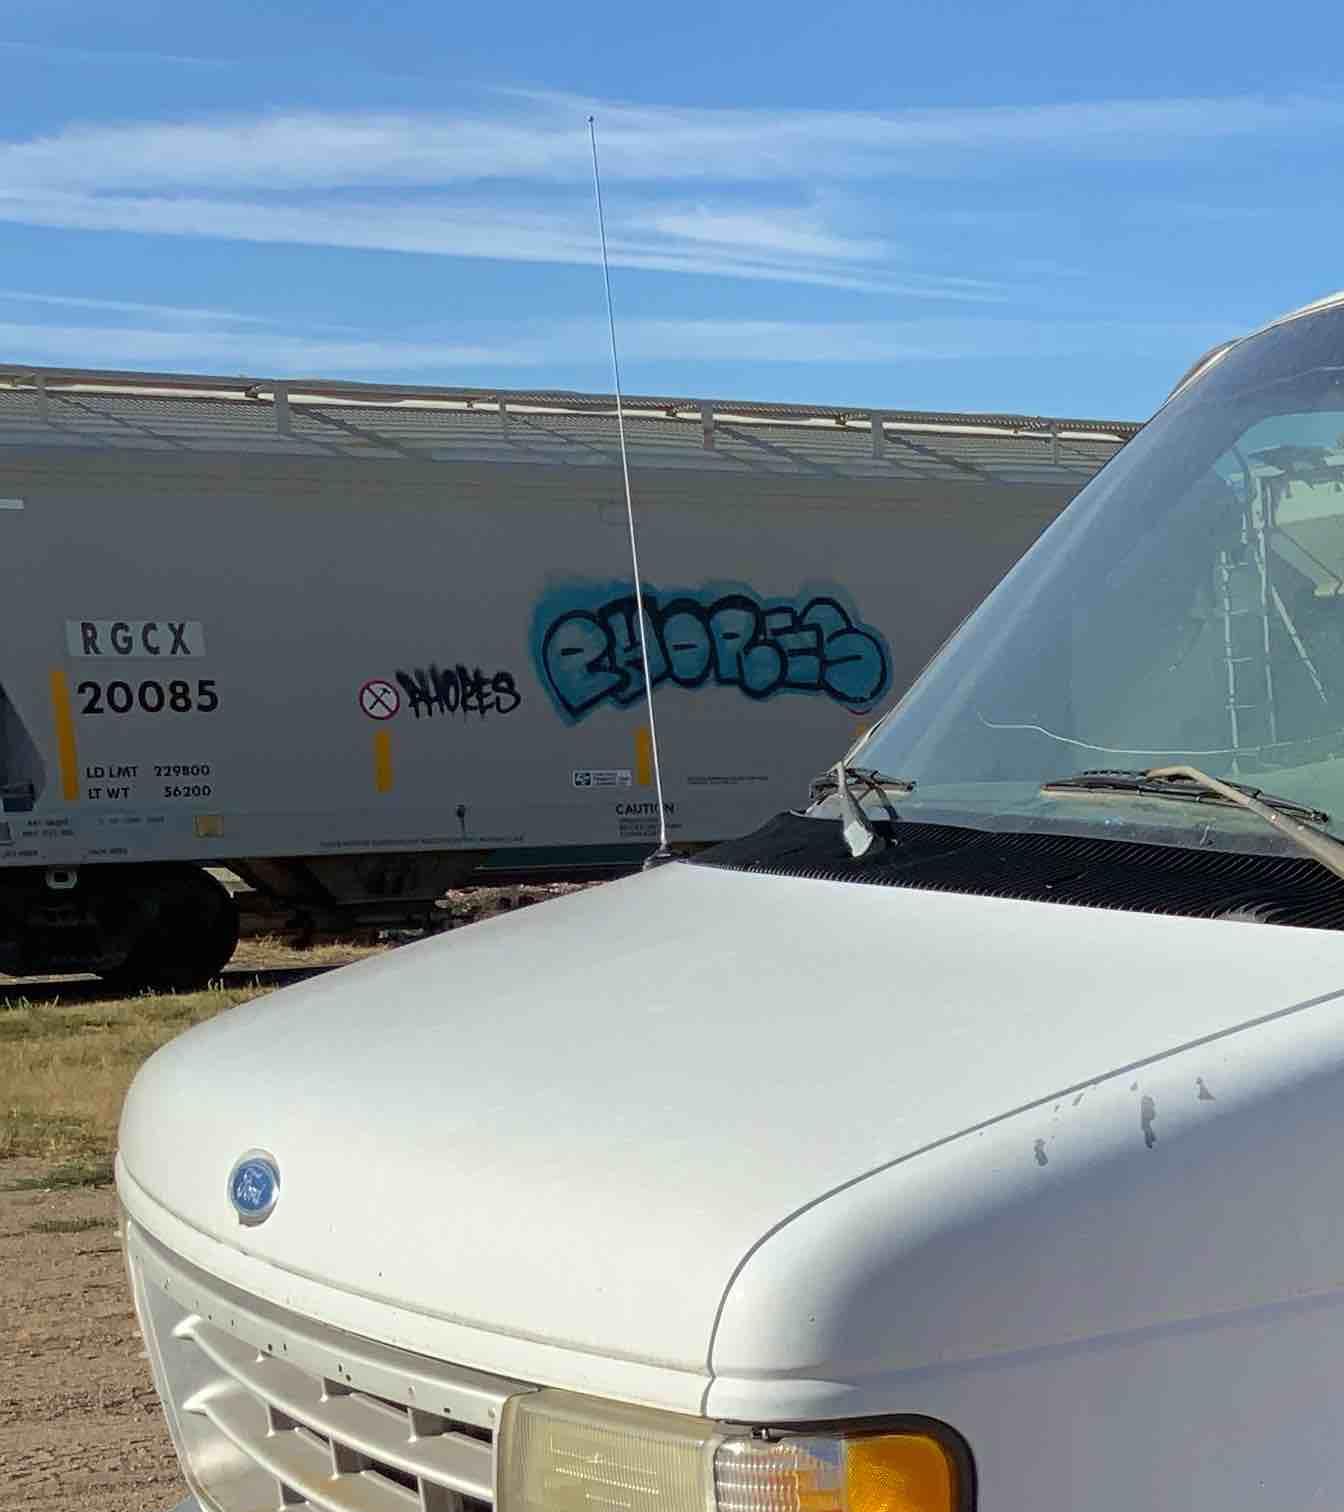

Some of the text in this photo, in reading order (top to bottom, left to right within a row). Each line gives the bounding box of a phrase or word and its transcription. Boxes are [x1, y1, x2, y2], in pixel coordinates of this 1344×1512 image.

[80, 621, 192, 656] RGCX
[77, 679, 219, 714] 20085
[86, 766, 105, 779] LD
[109, 765, 139, 779] LMT
[87, 784, 212, 800] LT WT 56200
[615, 802, 676, 816] CAUTION
